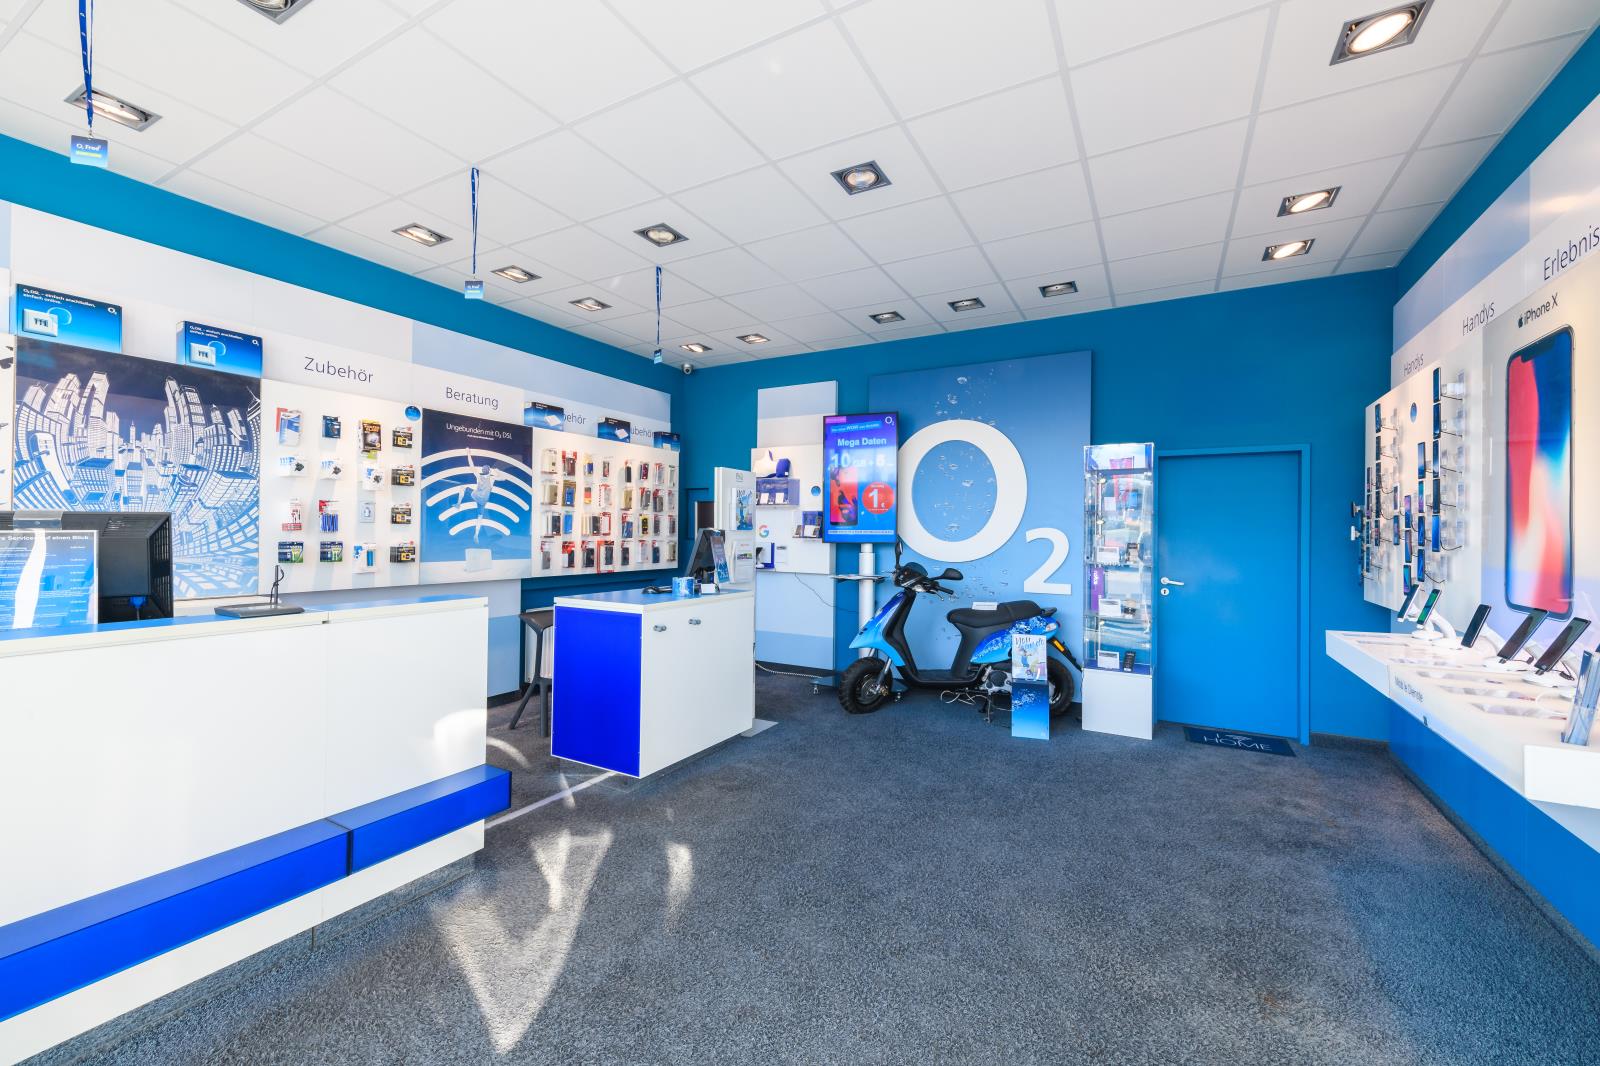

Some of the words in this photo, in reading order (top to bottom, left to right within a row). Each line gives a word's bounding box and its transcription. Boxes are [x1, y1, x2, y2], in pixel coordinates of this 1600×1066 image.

[1543, 225, 1600, 281] Erlebnis
[1462, 301, 1495, 337] Handys
[1524, 301, 1551, 325] iPhone
[1551, 292, 1558, 310] X
[304, 356, 374, 383] Zubehör
[446, 386, 499, 410] Beratung
[446, 422, 485, 434] Ungebunden
[837, 438, 860, 448] Mega
[861, 437, 887, 446] Daten
